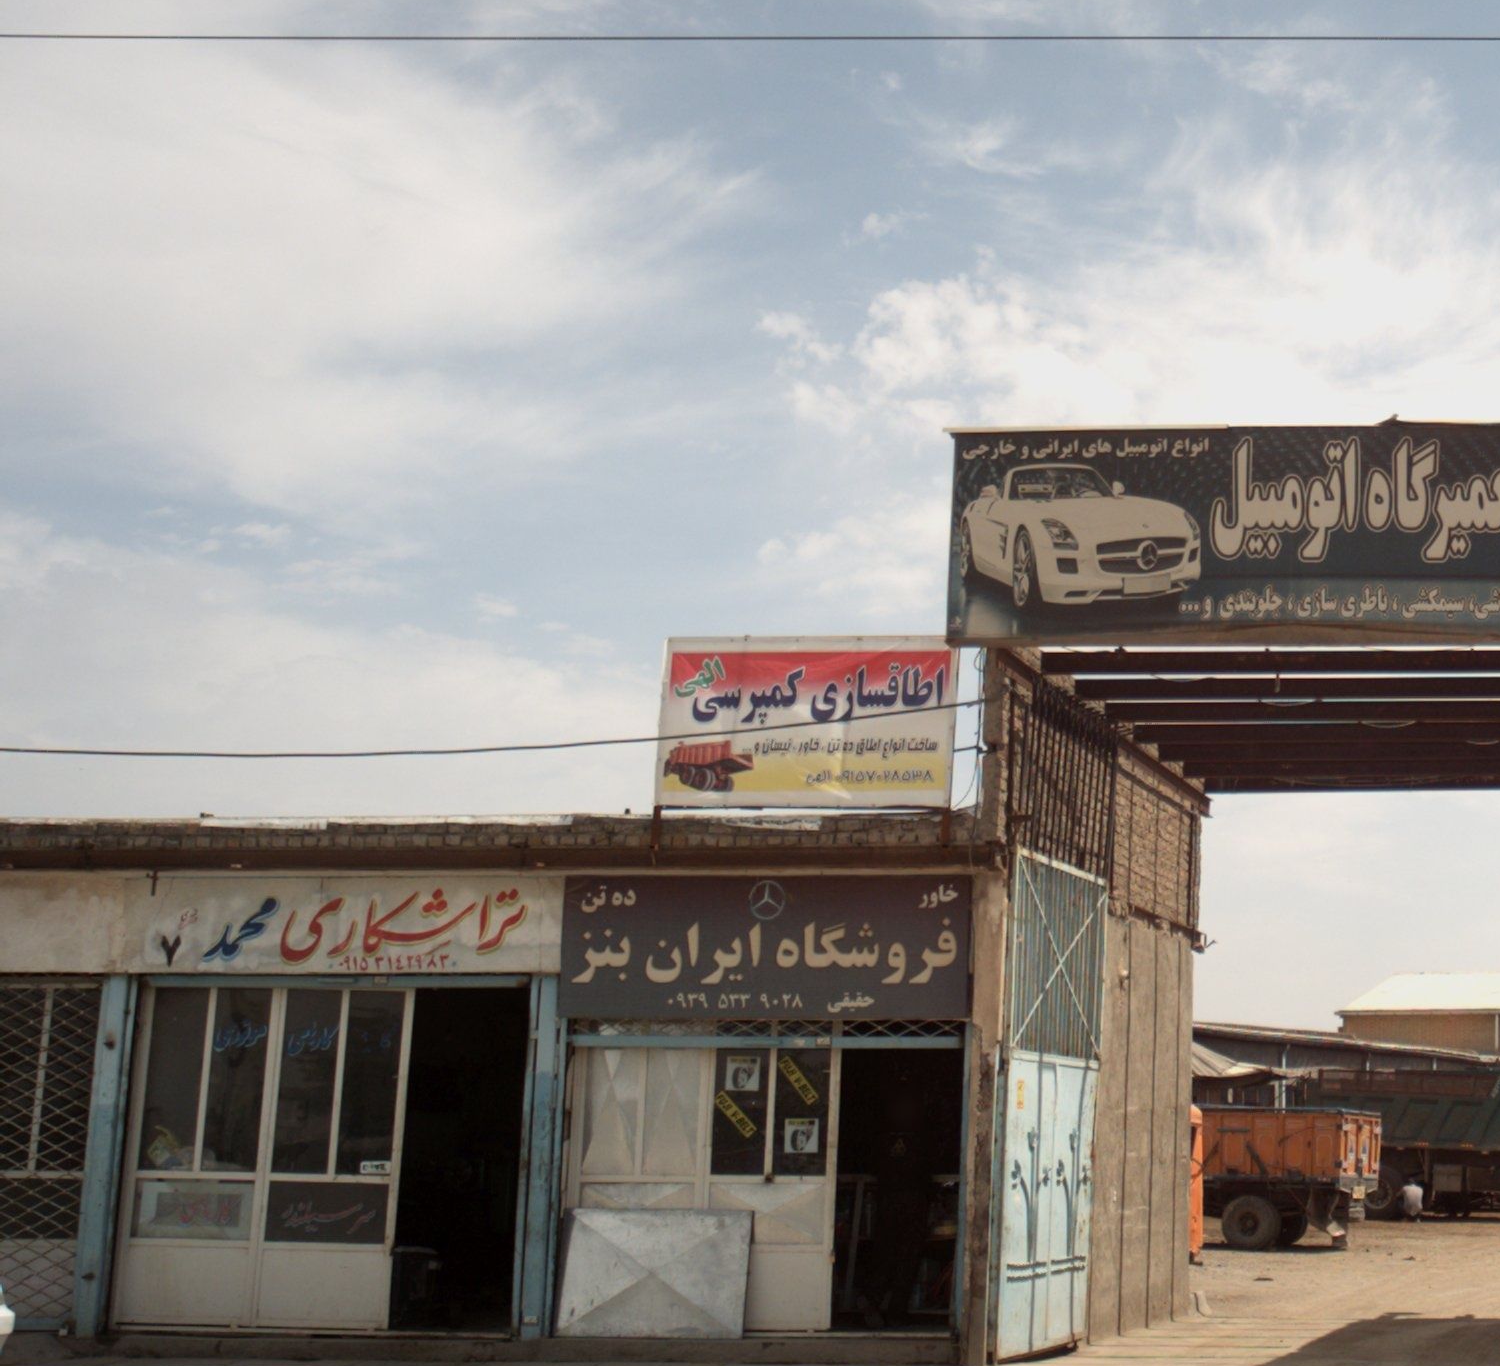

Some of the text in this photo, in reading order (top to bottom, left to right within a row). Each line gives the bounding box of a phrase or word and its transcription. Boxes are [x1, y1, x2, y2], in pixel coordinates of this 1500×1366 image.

[962, 437, 1210, 460] انواع اتومبیل های ایرانی و خارجی
[1210, 436, 1361, 564] اتومبیل
[1219, 585, 1283, 620] جلوبندی
[1340, 586, 1388, 619] باطری
[674, 656, 726, 699] الهی
[692, 662, 944, 726] اطاقسازی کمپرسی
[856, 739, 881, 757] اطاق
[882, 739, 905, 759] انواع
[907, 738, 938, 752] ساخت
[581, 885, 637, 913] ده تن
[919, 883, 959, 909] خاور
[200, 887, 530, 966] تراشکاری محمد
[160, 934, 183, 968] ۷
[571, 918, 958, 985] فروشگاه ایران بنز
[826, 991, 875, 1013] حقیقی
